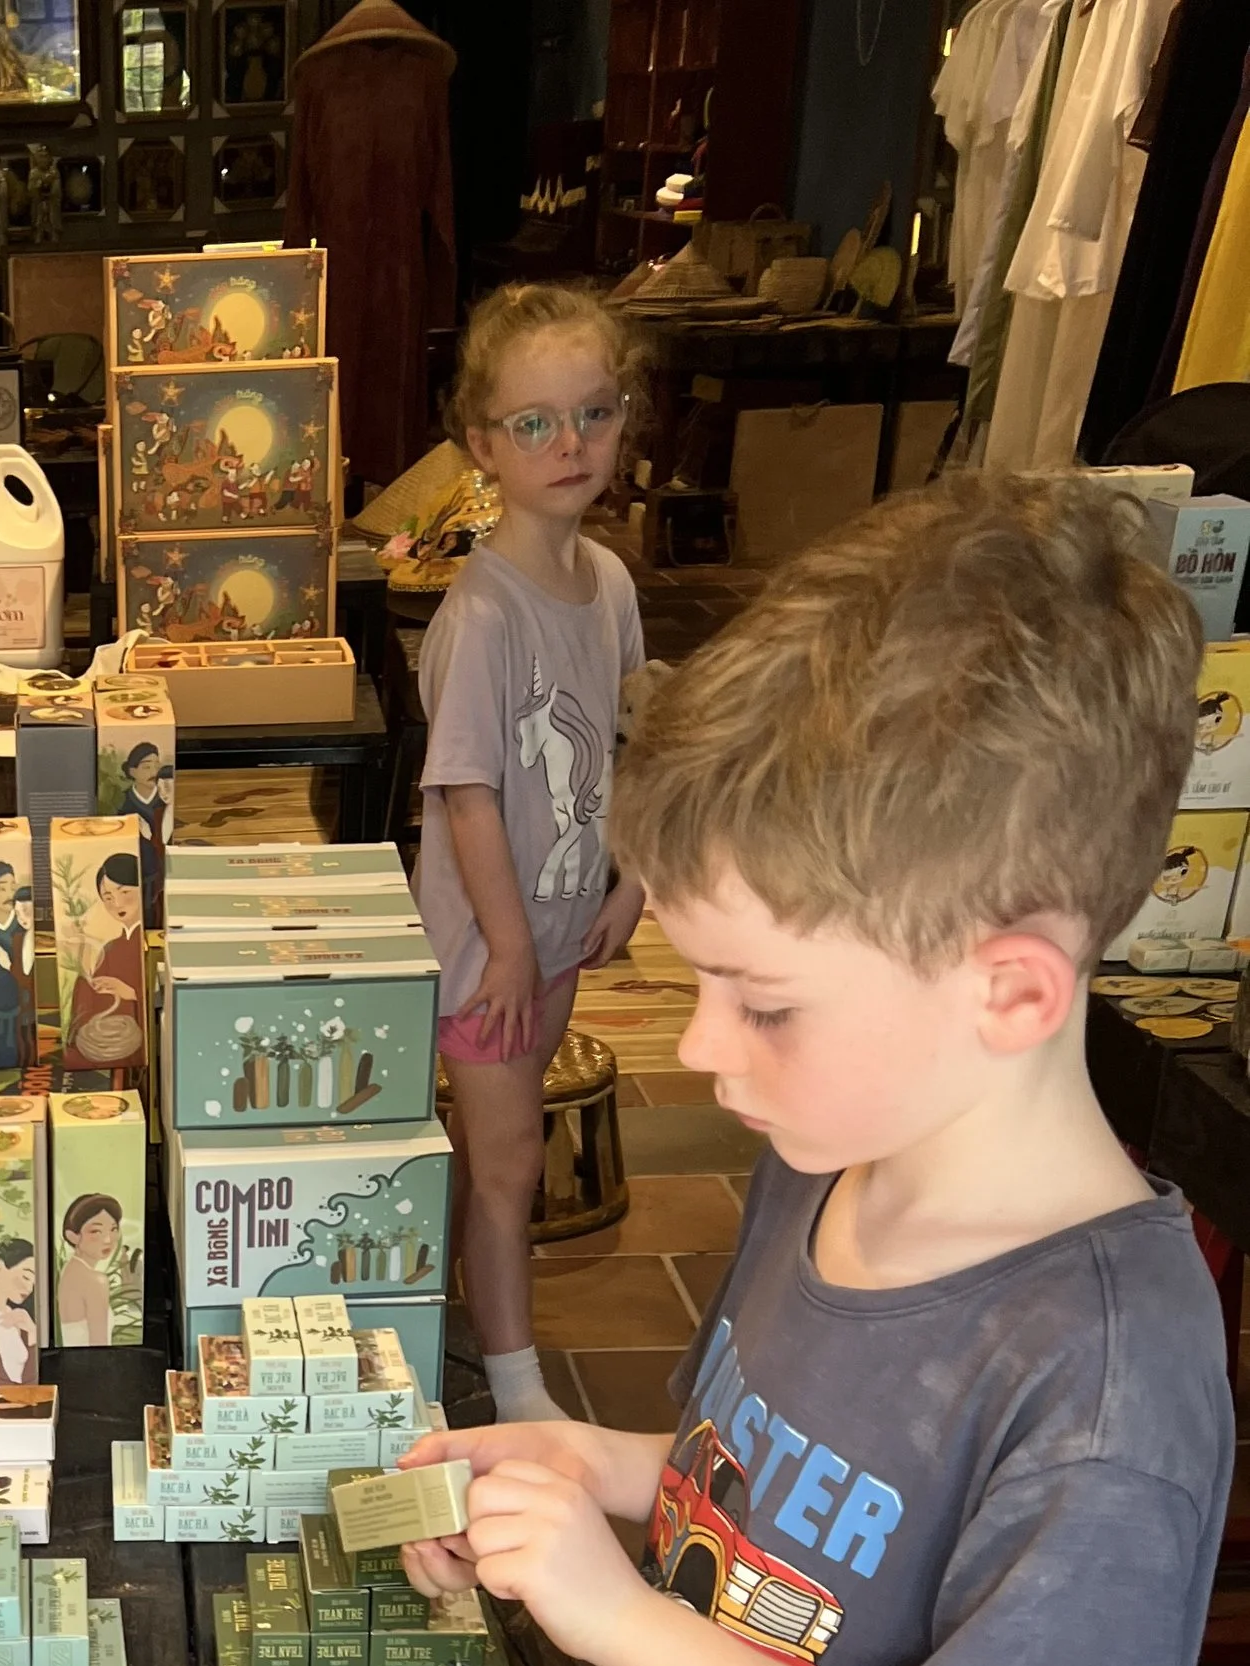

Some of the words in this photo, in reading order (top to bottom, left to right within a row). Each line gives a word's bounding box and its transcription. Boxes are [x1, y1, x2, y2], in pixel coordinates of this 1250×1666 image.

[318, 1609, 343, 1621] THAN
[344, 1608, 363, 1620] TRE
[379, 1604, 403, 1617] THAN
[404, 1603, 424, 1616] TRE
[385, 1647, 410, 1660] THAN
[412, 1647, 432, 1659] TRE
